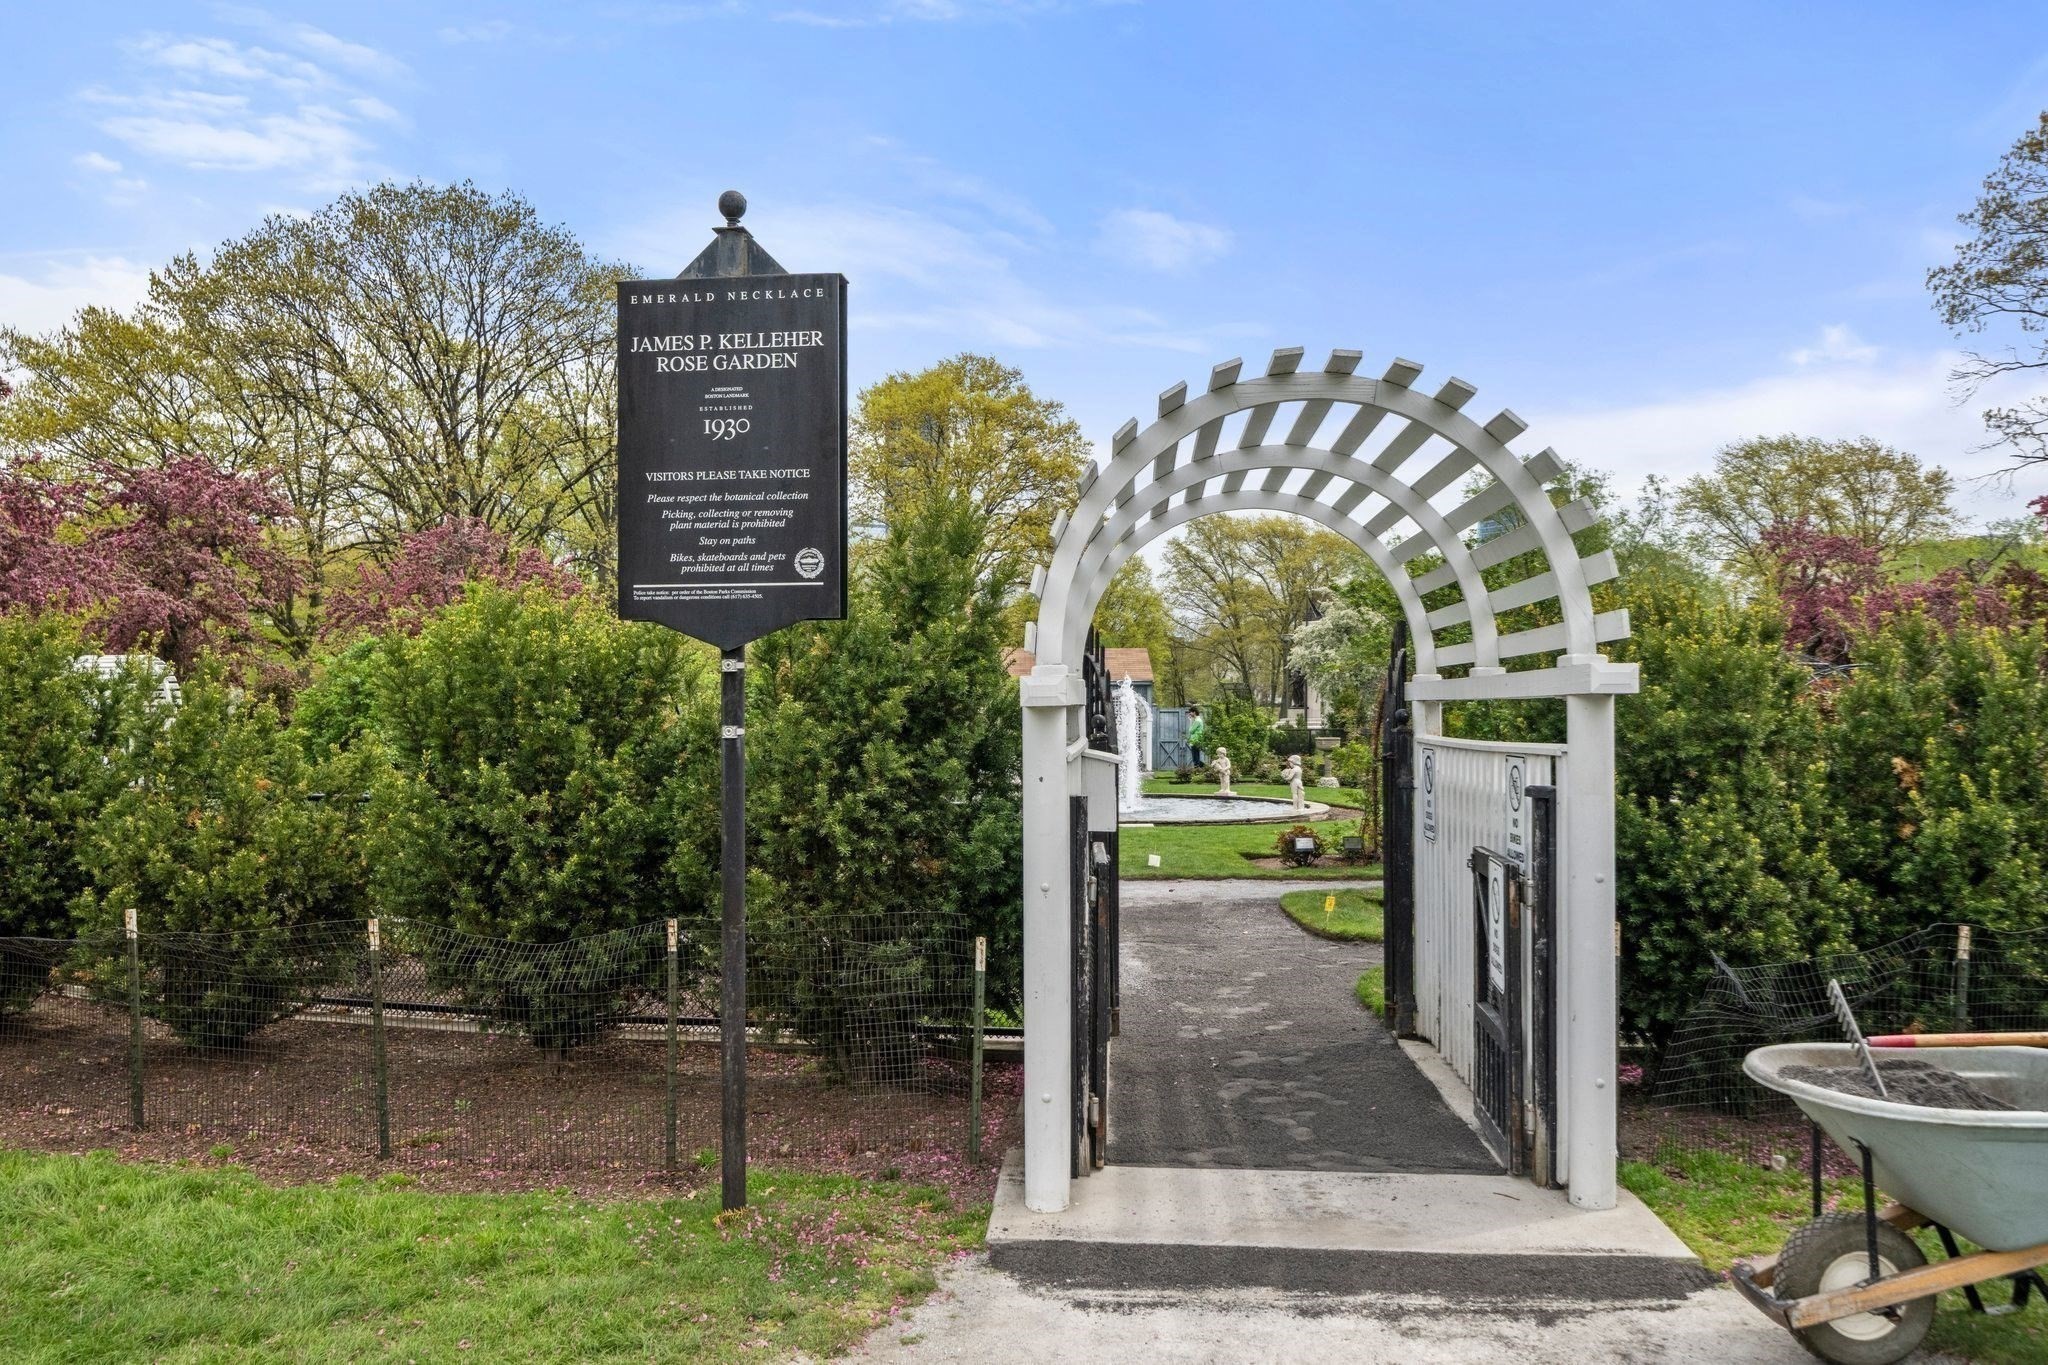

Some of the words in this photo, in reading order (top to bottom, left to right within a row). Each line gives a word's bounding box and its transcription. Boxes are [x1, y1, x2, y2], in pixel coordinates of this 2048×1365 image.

[631, 293, 715, 304] EMERALD
[728, 288, 824, 300] NECKLACE
[631, 335, 693, 352] JAMES
[700, 335, 712, 350] P.
[719, 331, 824, 350] KELLEHER
[656, 356, 708, 372] ROSE
[713, 353, 798, 370] GARDEN
[704, 418, 750, 441] 1930
[646, 472, 693, 482] VISITORS
[696, 471, 736, 480] PLEASE
[738, 470, 768, 479] TAKE
[770, 469, 810, 478] NOTICE
[647, 494, 674, 503] Please
[677, 493, 707, 502] respect
[710, 493, 722, 501] the
[724, 492, 764, 501] botanical
[767, 492, 808, 500] collection
[662, 510, 696, 520] Picking,
[698, 509, 740, 519] collecting
[754, 508, 793, 518] removing
[670, 521, 692, 531] plant
[694, 520, 729, 529] material
[732, 520, 739, 528] is
[741, 519, 785, 530] prohibited
[699, 537, 717, 546] Stay
[732, 536, 755, 546] paths
[670, 554, 695, 562] Bikes,
[698, 553, 748, 561] skateboards
[750, 552, 766, 560] and
[768, 553, 786, 562] pets
[681, 564, 724, 574] prohibited
[727, 564, 736, 572] at
[738, 563, 749, 572] all
[751, 563, 774, 571] times
